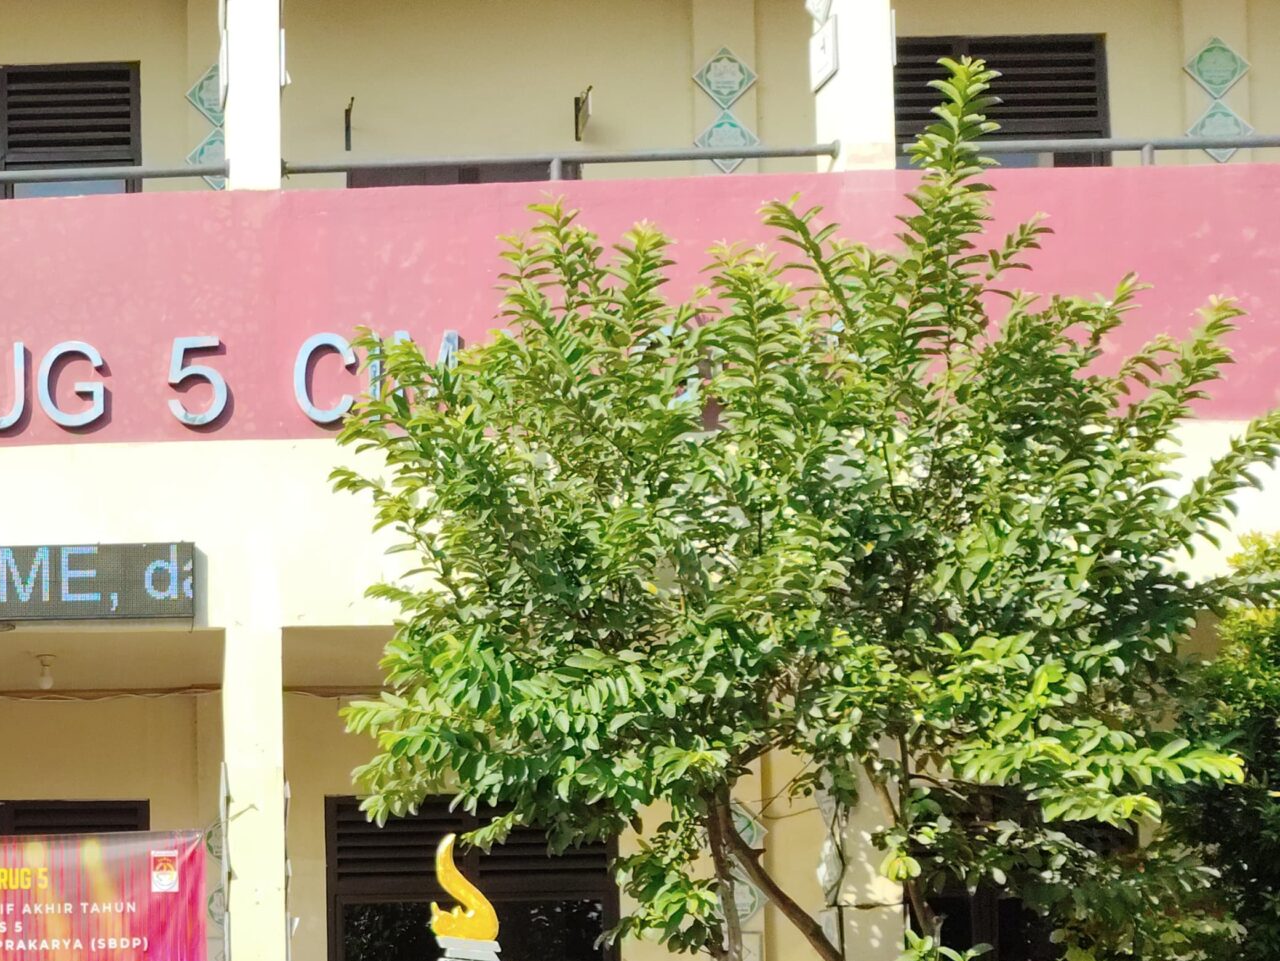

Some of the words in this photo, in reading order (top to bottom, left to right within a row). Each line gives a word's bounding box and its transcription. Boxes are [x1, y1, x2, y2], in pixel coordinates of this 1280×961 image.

[167, 336, 230, 425] 5
[38, 867, 49, 890] 5
[21, 902, 74, 916] AKHIR
[80, 901, 137, 915] TAHUN
[13, 920, 23, 934] 5
[90, 936, 149, 953] (SBDP)
